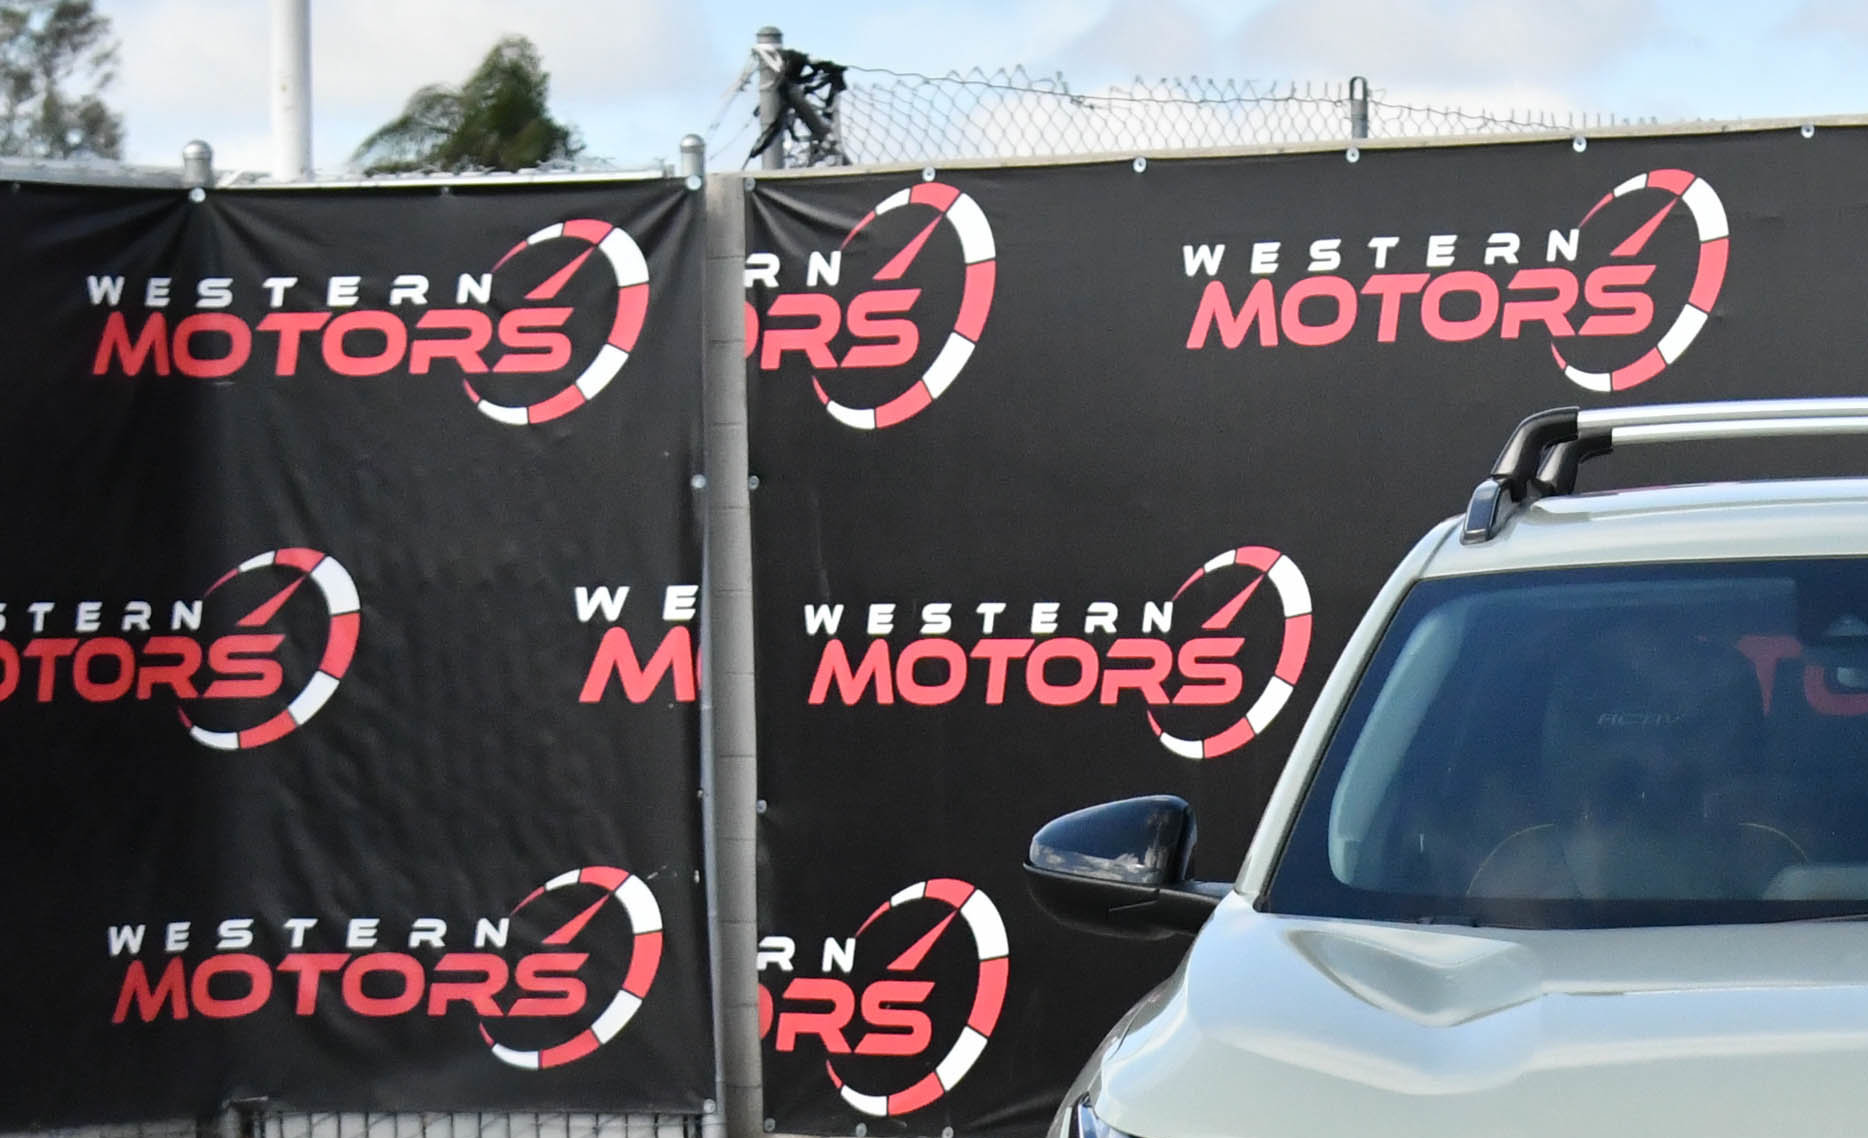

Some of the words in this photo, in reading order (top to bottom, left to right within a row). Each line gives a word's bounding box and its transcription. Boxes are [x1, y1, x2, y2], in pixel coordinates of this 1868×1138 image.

[743, 250, 842, 288] RN
[1182, 228, 1581, 278] WESTERN
[88, 273, 493, 308] WESTERN
[1186, 263, 1658, 351] MOTORS
[93, 306, 574, 379] MOTORS
[743, 287, 922, 371] RS
[0, 600, 203, 633] TERN
[574, 584, 700, 623] WE
[804, 601, 1174, 636] WESTERN
[0, 632, 285, 702] TORS
[578, 625, 703, 706] M
[807, 636, 1246, 707] MOTORS
[109, 917, 510, 955] WESTERN
[757, 936, 856, 973] RN
[113, 951, 591, 1024] MOTORS
[757, 977, 936, 1057] RS
